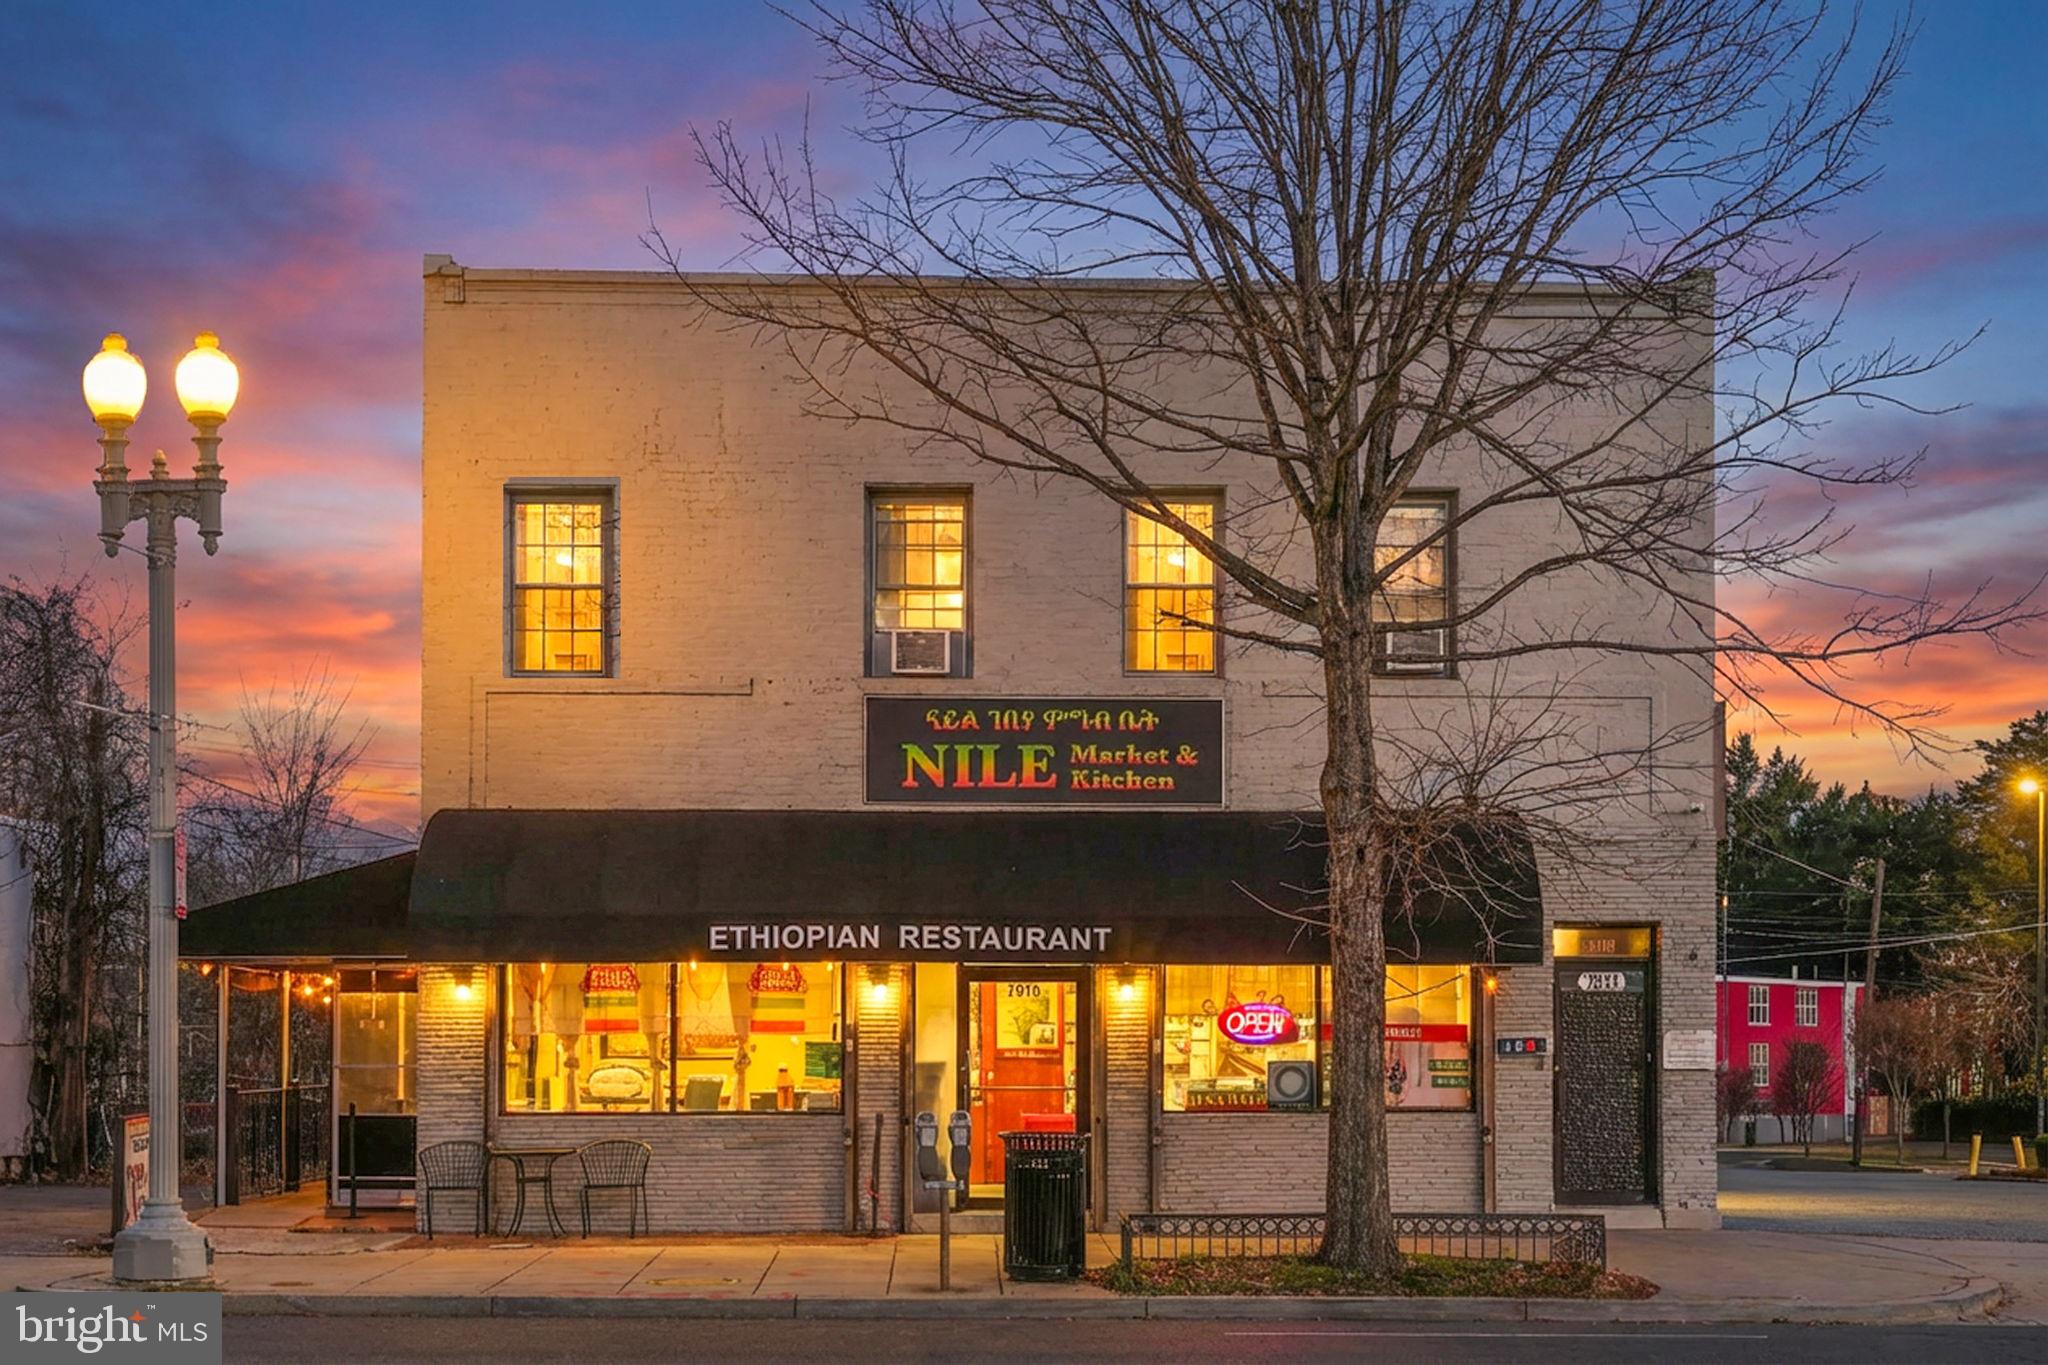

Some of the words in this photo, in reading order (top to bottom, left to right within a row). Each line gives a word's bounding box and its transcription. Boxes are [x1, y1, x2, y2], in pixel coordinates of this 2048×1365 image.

[1118, 708, 1160, 731] ቤት
[900, 743, 1057, 789] NILE
[1070, 743, 1169, 766] Market
[1175, 744, 1198, 766] &
[1070, 769, 1175, 791] Kitchen
[708, 924, 881, 951] ETHIOPIAN
[898, 925, 1113, 952] RESTAURANT
[1008, 984, 1041, 998] 7910
[1226, 1011, 1284, 1034] OPEN
